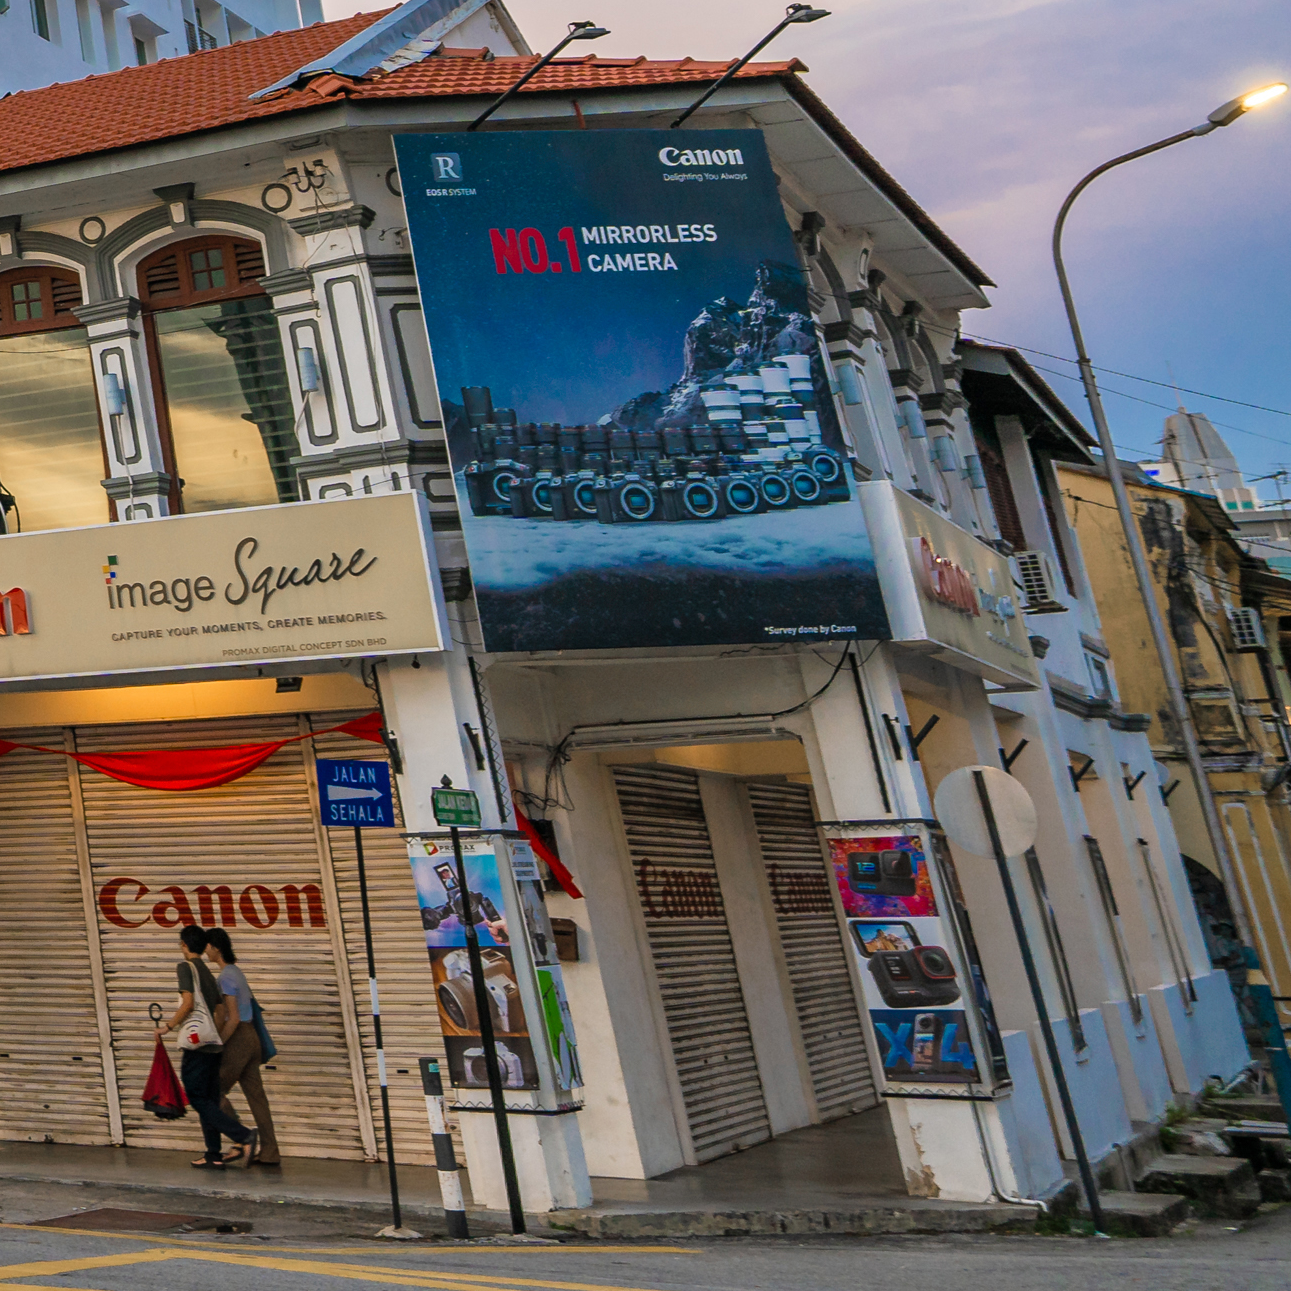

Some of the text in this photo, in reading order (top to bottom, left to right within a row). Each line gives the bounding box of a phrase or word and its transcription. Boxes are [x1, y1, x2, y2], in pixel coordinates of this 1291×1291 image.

[659, 146, 744, 166] Canon
[436, 156, 459, 179] R
[663, 172, 748, 182] Delighting You Always
[426, 188, 442, 196] EOS
[448, 188, 477, 196] SYSTEM
[489, 223, 717, 274] NO.1 MIRRORLESS
[587, 252, 678, 272] CAMERA
[104, 560, 216, 612] image
[225, 537, 378, 615] Square
[111, 611, 388, 642] CAPTURE YOUR MOMENTS, CREATE MEMORIES.
[798, 625, 819, 634] done
[819, 624, 830, 635] by
[830, 624, 857, 633] Canon
[222, 637, 387, 657] PROMAX DIGITAL CONCEPT SDN BHD
[332, 765, 376, 783] JALAN
[330, 804, 385, 822] SEHALA
[439, 844, 476, 852] PROAX
[639, 857, 722, 919] Canon
[99, 877, 326, 928] Canon
[874, 1022, 914, 1068] X
